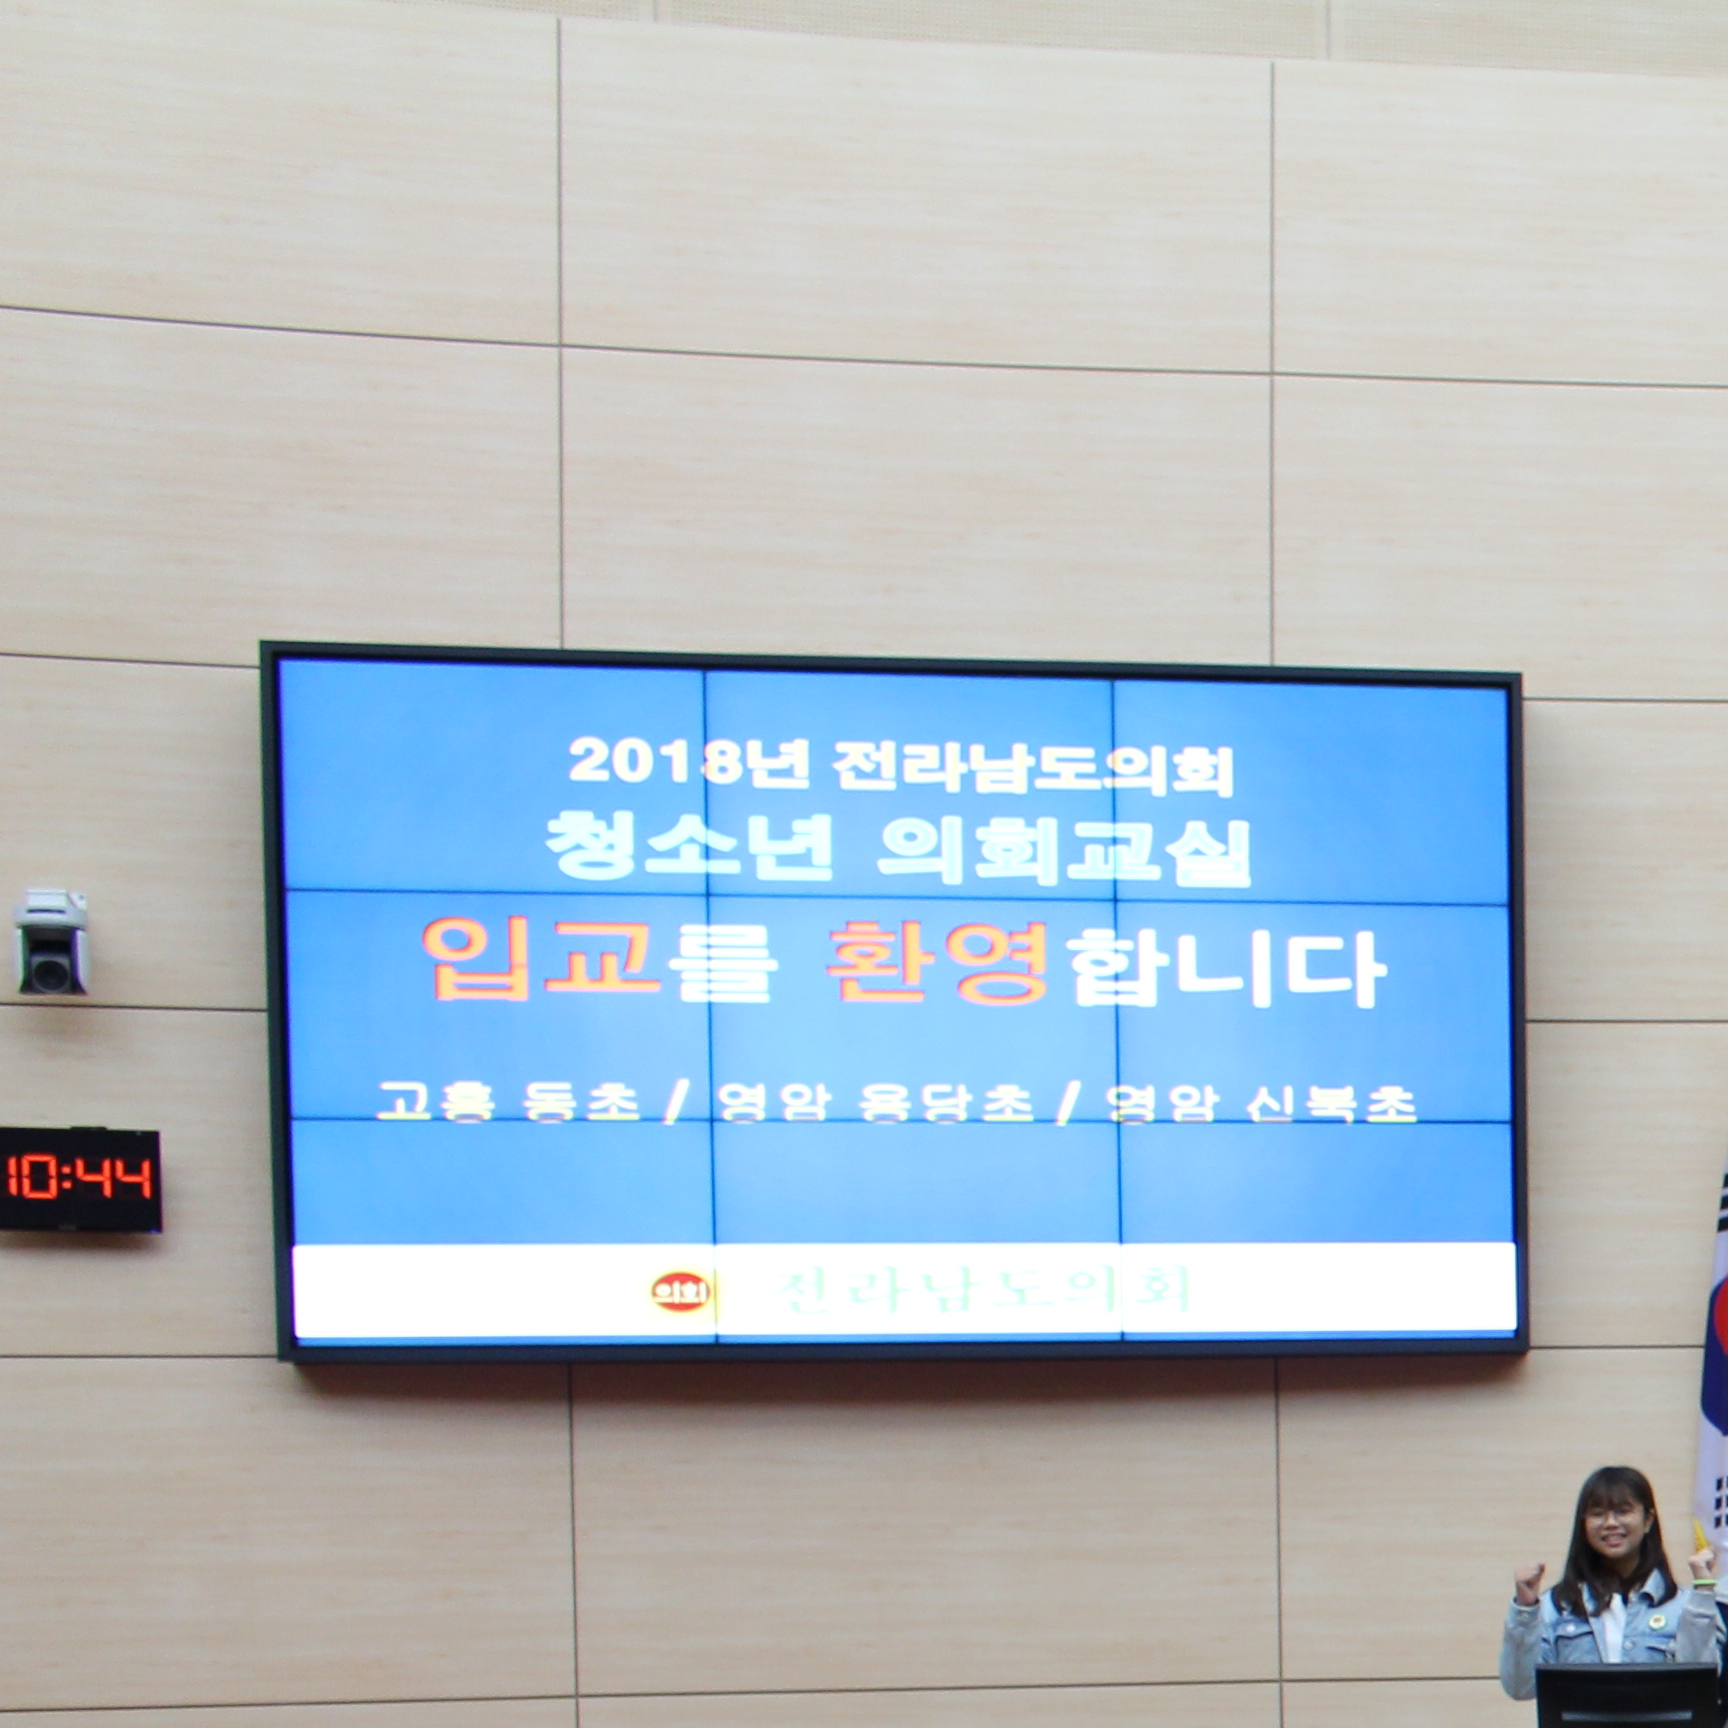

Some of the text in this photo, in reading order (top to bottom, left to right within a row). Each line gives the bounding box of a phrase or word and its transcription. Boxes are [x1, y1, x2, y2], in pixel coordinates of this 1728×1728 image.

[569, 736, 1234, 798] 2018년 전라남도의회
[546, 810, 1252, 888] 청소년 의회교실
[422, 915, 1389, 1010] 입교를 환영합니다
[522, 1081, 640, 1125] 동초
[717, 1082, 834, 1125] 영암
[1104, 1084, 1221, 1126] 영암
[1245, 1085, 1418, 1126] 신북초
[7, 1152, 154, 1200] 10:44
[776, 1260, 1193, 1315] 전라남도의회
